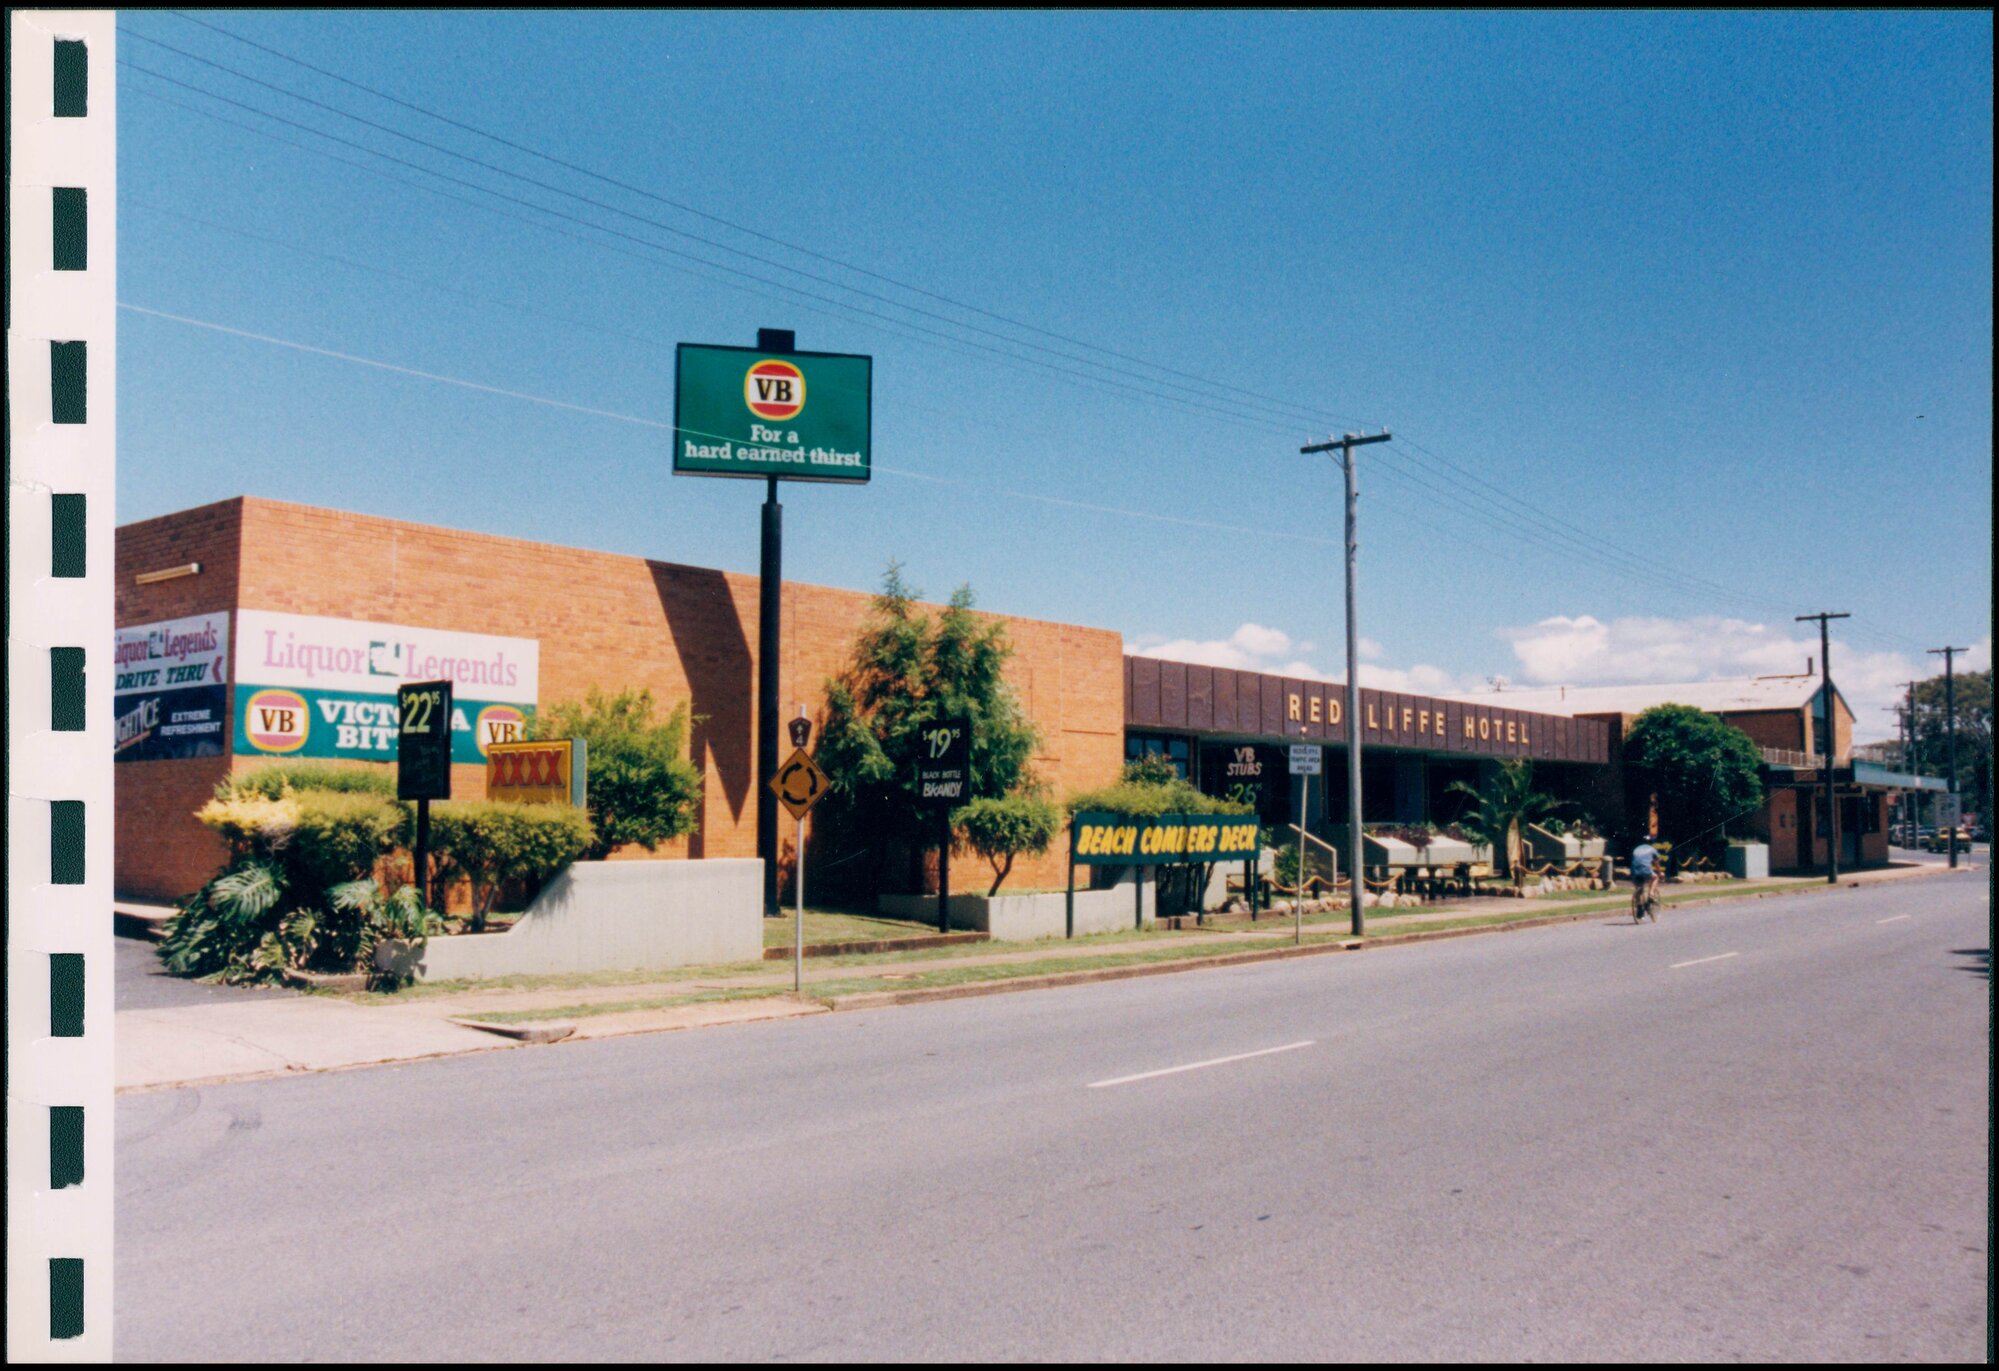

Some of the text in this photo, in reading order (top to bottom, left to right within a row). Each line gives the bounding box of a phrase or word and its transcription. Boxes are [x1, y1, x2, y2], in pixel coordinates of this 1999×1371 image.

[755, 378, 792, 402] VB
[750, 425, 799, 443] For a
[685, 441, 861, 466] hard earned thirst
[115, 621, 218, 668] iquor Legends
[263, 630, 518, 687] Liquor Legends
[115, 663, 209, 690] DRIVE THRU
[260, 708, 295, 732] VB
[316, 699, 471, 731] VICTA
[161, 722, 221, 736] REFRESHMENT
[1465, 716, 1530, 744] HOTEL
[1234, 747, 1255, 762] VB
[490, 750, 564, 788] XXXX
[1227, 762, 1262, 776] STUBS
[923, 782, 962, 797] BRANDY
[1077, 825, 1137, 855] BEACH
[1219, 824, 1257, 850] DECK
